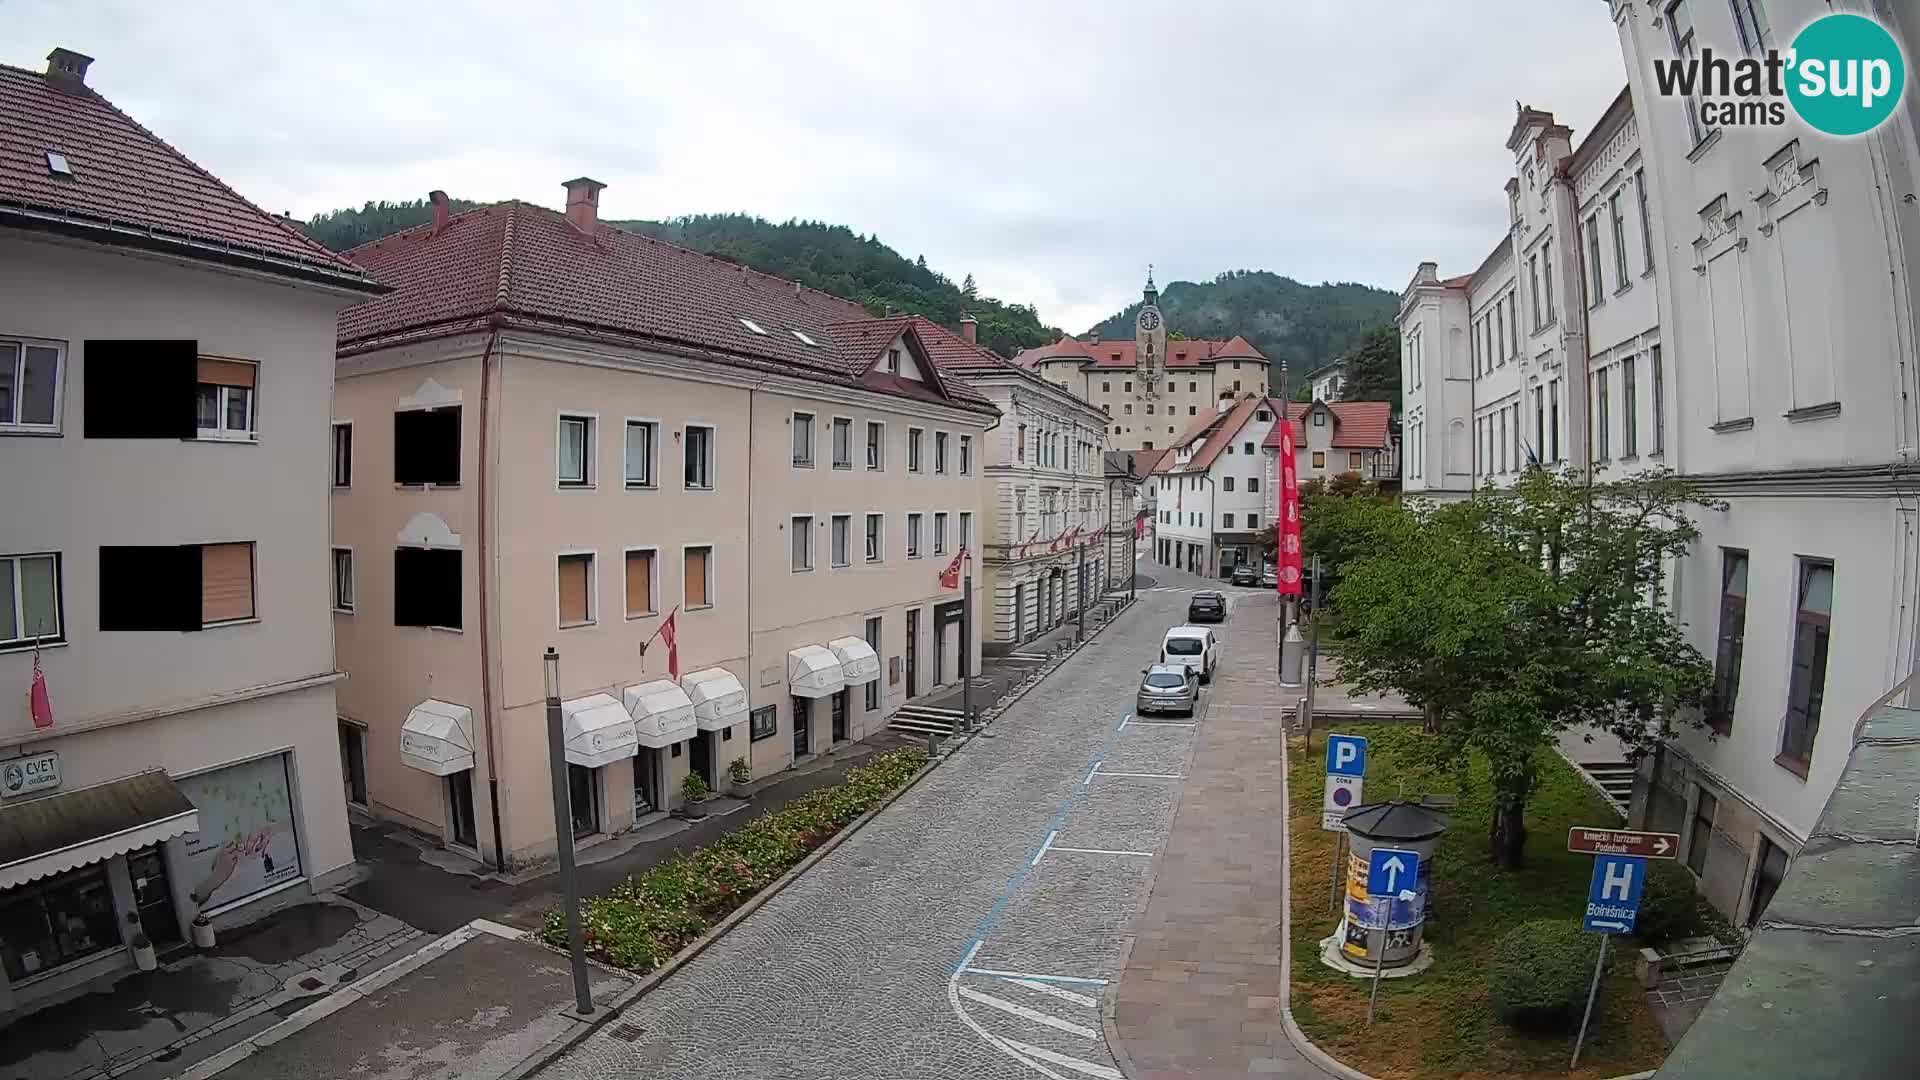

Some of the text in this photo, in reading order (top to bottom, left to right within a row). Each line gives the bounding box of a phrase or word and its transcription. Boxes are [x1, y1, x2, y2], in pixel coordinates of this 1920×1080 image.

[26, 758, 55, 775] CVET
[1335, 742, 1357, 769] P
[1602, 862, 1633, 901] H
[1586, 902, 1635, 920] Bolnišnica
